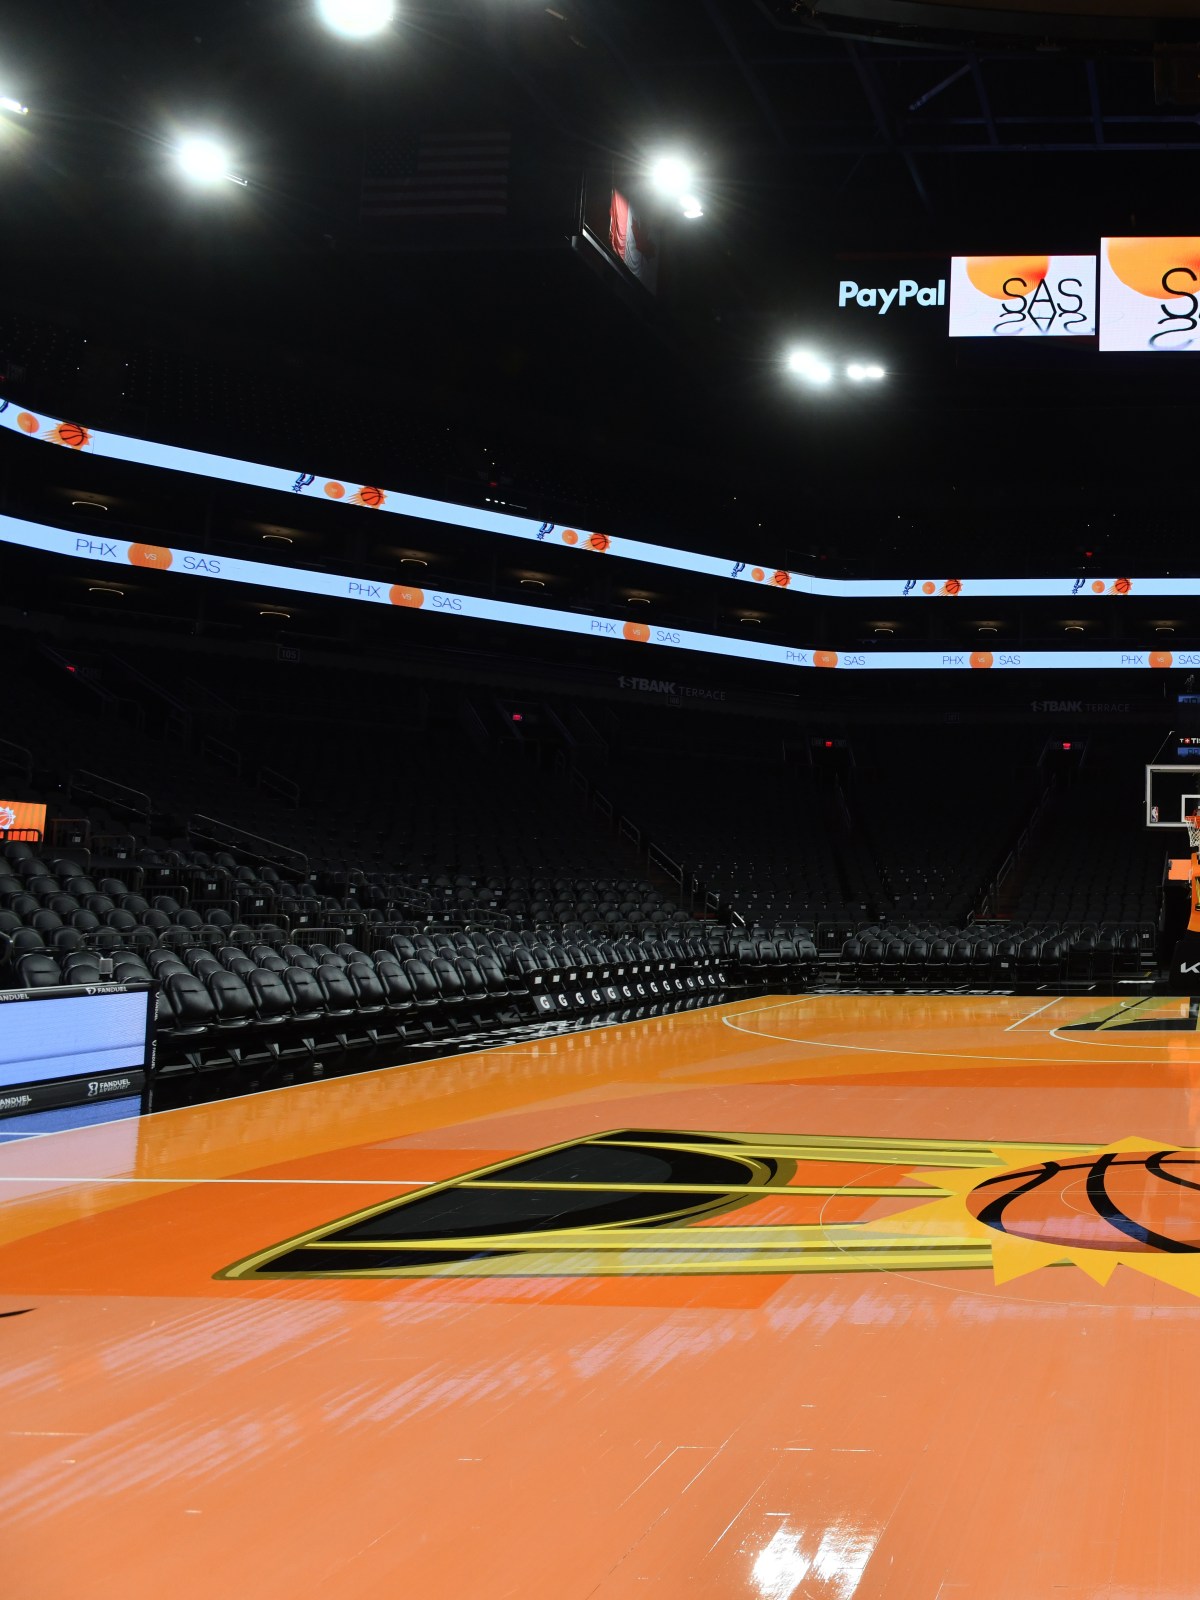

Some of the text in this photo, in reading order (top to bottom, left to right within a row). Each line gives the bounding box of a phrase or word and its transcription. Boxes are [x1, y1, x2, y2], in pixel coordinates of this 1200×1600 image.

[838, 279, 945, 315] PayPal
[1002, 278, 1083, 313] SAS
[76, 538, 117, 558] PHX
[183, 556, 220, 573] SAS
[348, 582, 381, 598] PHX
[432, 595, 462, 610] SAS
[591, 620, 616, 634] PHX
[656, 630, 680, 643] SAS
[786, 650, 807, 663] PHX
[844, 655, 865, 666] SAS
[942, 655, 964, 665] PHX
[999, 655, 1020, 665] SAS
[1121, 655, 1143, 665] PHX
[1178, 655, 1200, 665] SAS
[678, 686, 726, 701] TERRACE
[687, 978, 694, 987] G
[698, 976, 705, 985] G
[708, 975, 715, 984] G
[719, 973, 725, 982] G
[636, 984, 645, 994] G
[651, 982, 658, 992] G
[663, 981, 670, 991] G
[675, 979, 682, 989] G
[0, 993, 29, 1001] ANDUEL
[592, 989, 601, 1001] G
[607, 988, 616, 999] G
[623, 986, 631, 997] G
[540, 997, 550, 1009] G
[558, 994, 568, 1006] G
[576, 993, 585, 1004] G
[99, 1079, 131, 1089] FANDUEL
[0, 1095, 32, 1106] ANDUEL
